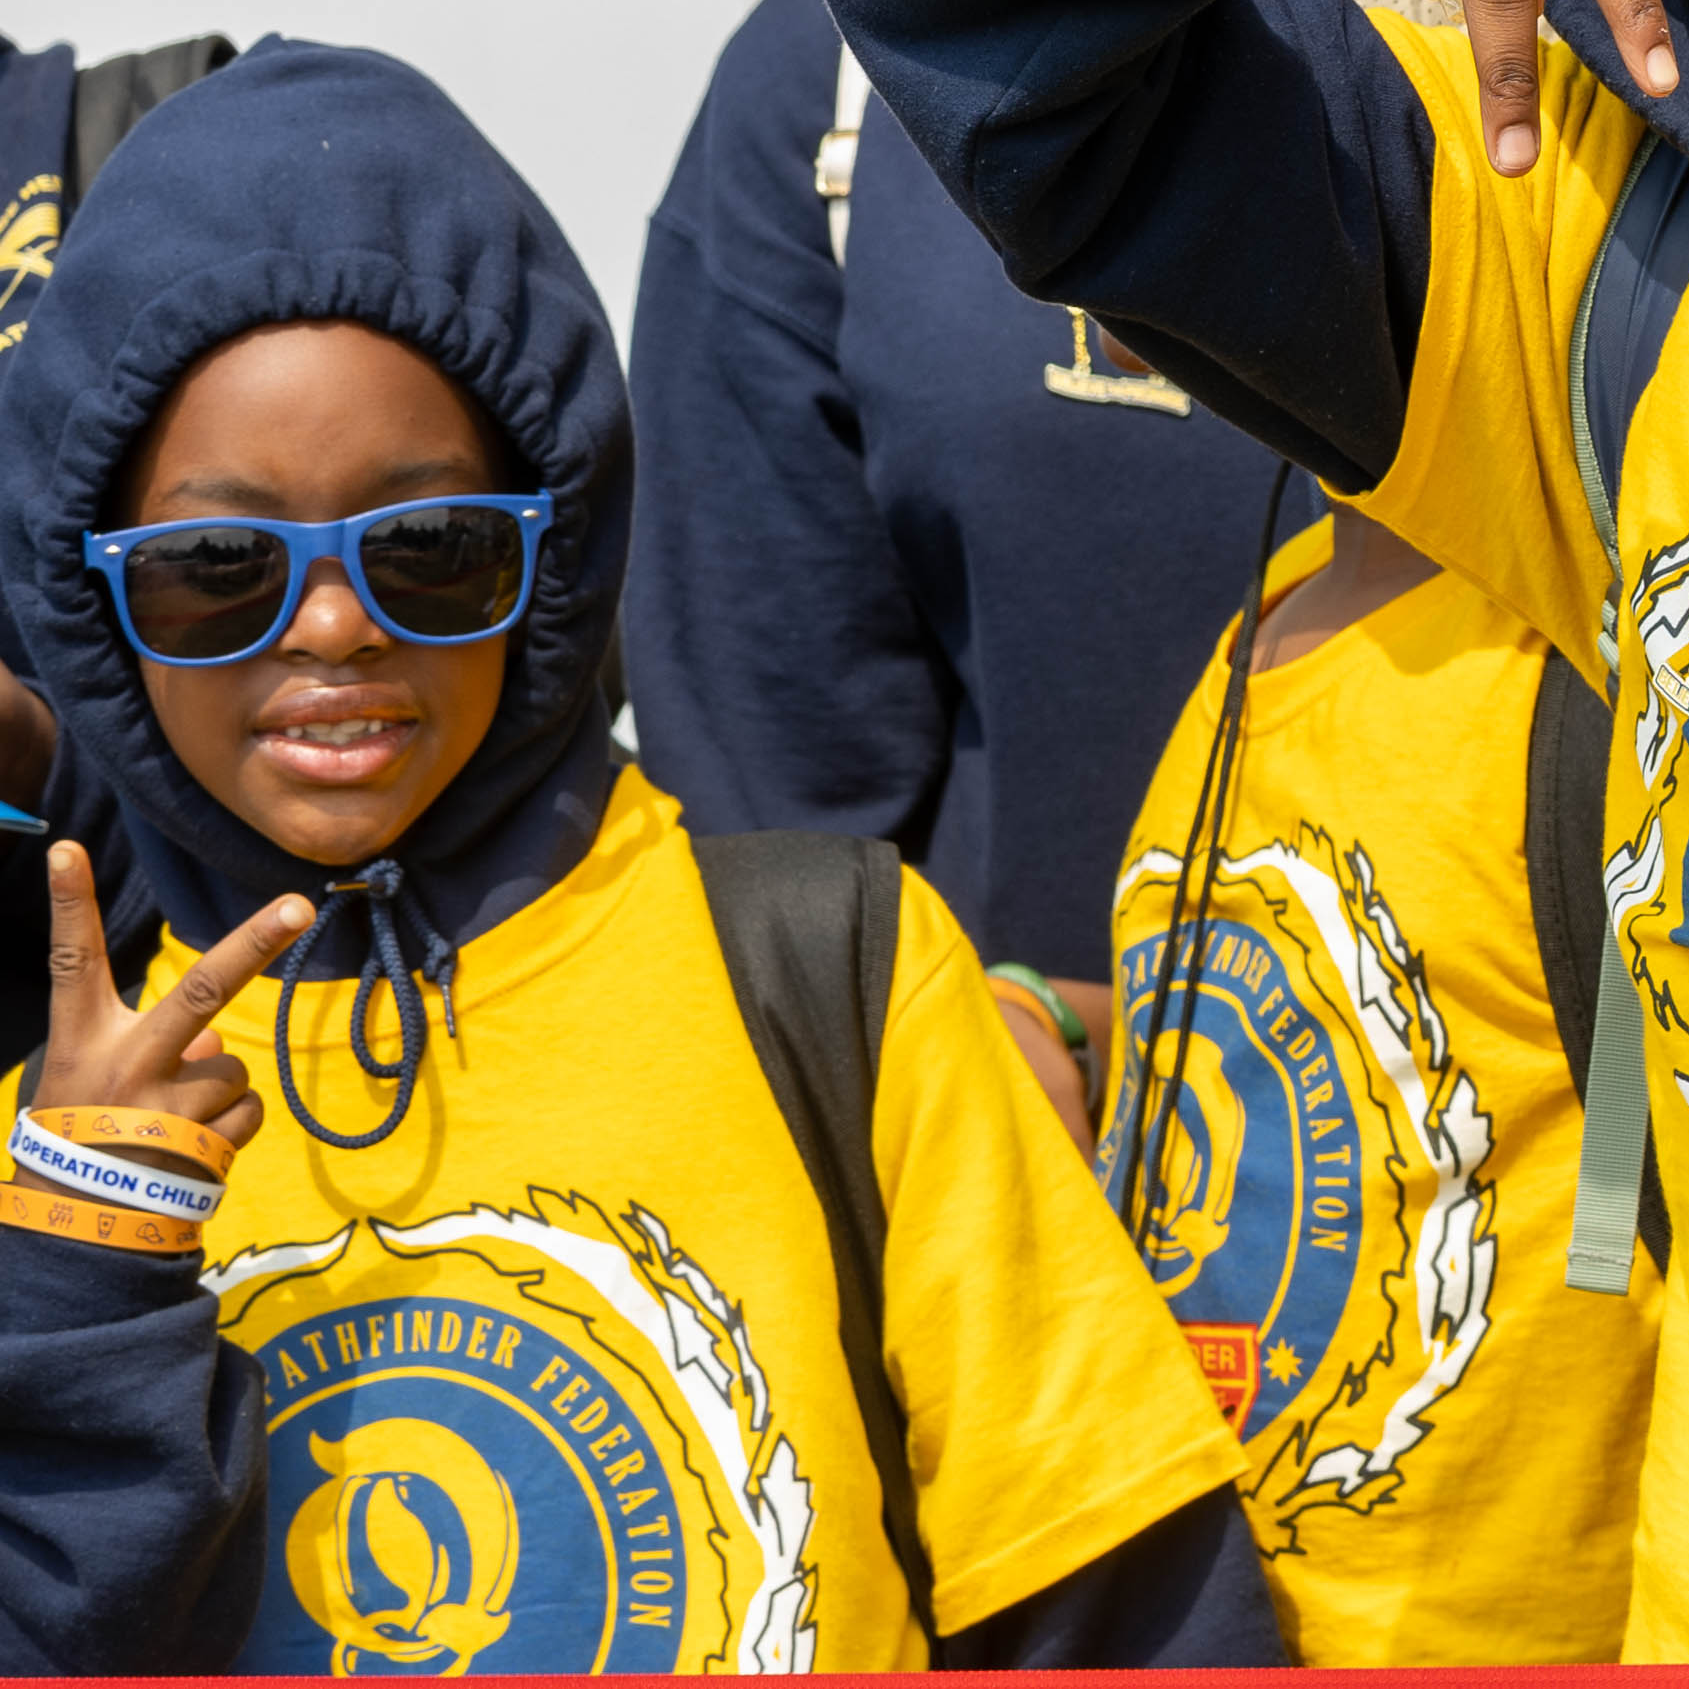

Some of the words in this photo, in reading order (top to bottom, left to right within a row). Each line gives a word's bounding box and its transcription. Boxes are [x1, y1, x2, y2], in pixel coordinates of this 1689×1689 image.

[21, 1134, 139, 1193] OPERATION
[144, 1181, 213, 1213] CHILD
[1256, 986, 1350, 1254] FEDERATION
[530, 1354, 674, 1630] FEDERATION
